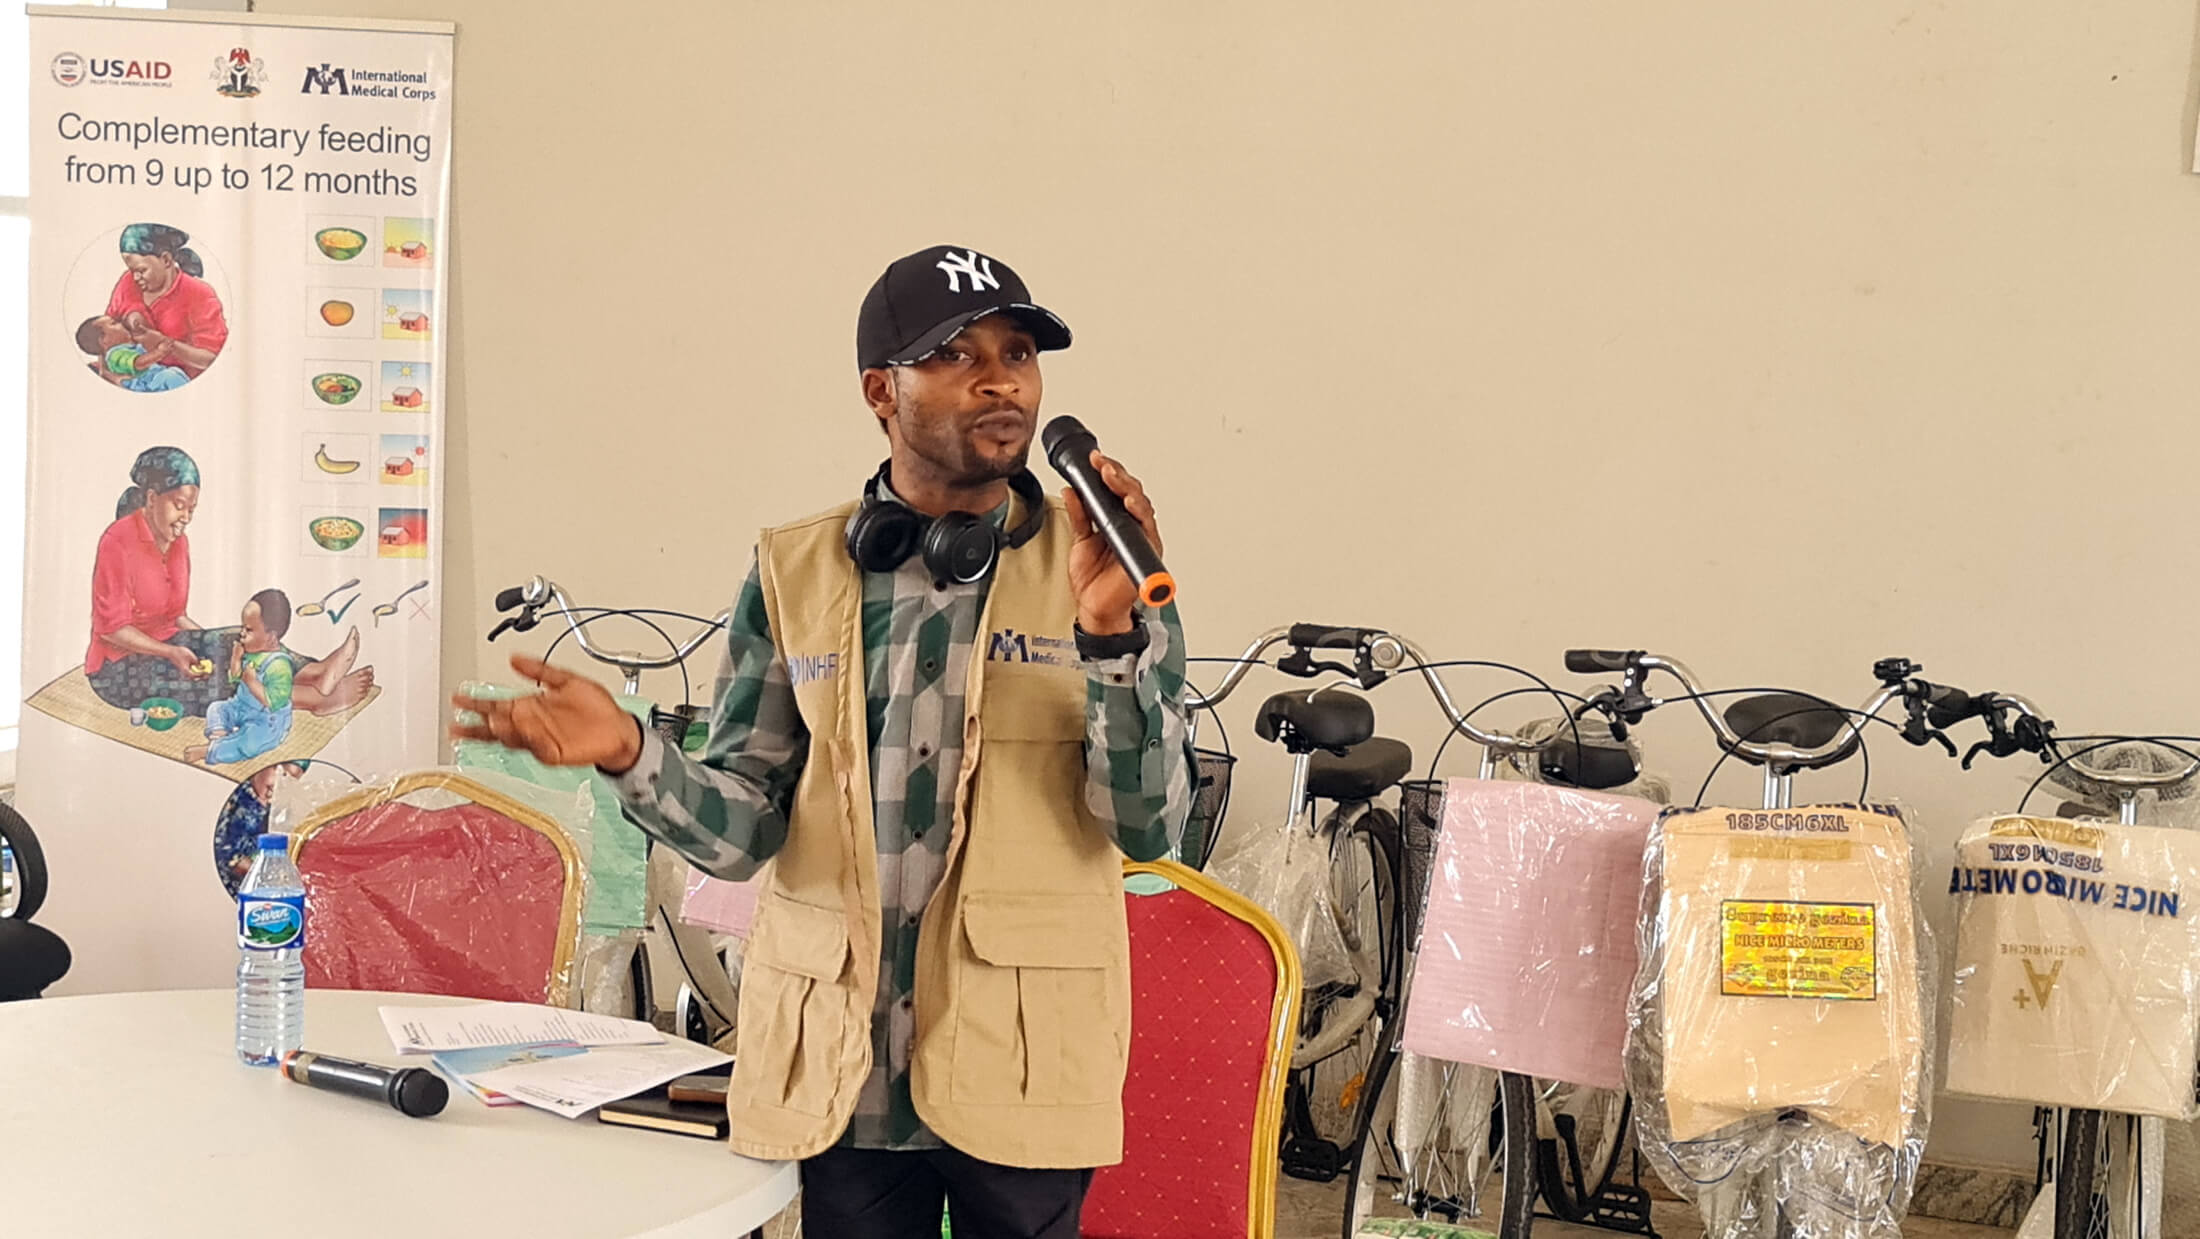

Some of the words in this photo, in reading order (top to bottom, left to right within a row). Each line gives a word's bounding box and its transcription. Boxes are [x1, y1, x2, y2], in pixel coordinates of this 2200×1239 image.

[90, 58, 172, 79] USAID
[351, 69, 427, 83] International
[351, 85, 398, 98] Medical
[402, 86, 436, 102] Corps
[58, 112, 310, 157] Complementary
[318, 123, 431, 162] feeding
[65, 155, 135, 185] from
[146, 158, 164, 186] 9
[174, 166, 212, 194] up
[222, 163, 249, 189] to
[261, 163, 294, 191] 12
[305, 168, 417, 196] months
[936, 250, 1001, 293] NY
[1726, 813, 1849, 832] 185CM6XL
[2113, 884, 2179, 917] NICE
[252, 907, 289, 923] Swan
[1735, 934, 1765, 948] NICE
[1767, 935, 1810, 949] MICRO
[1811, 936, 1865, 951] METERS
